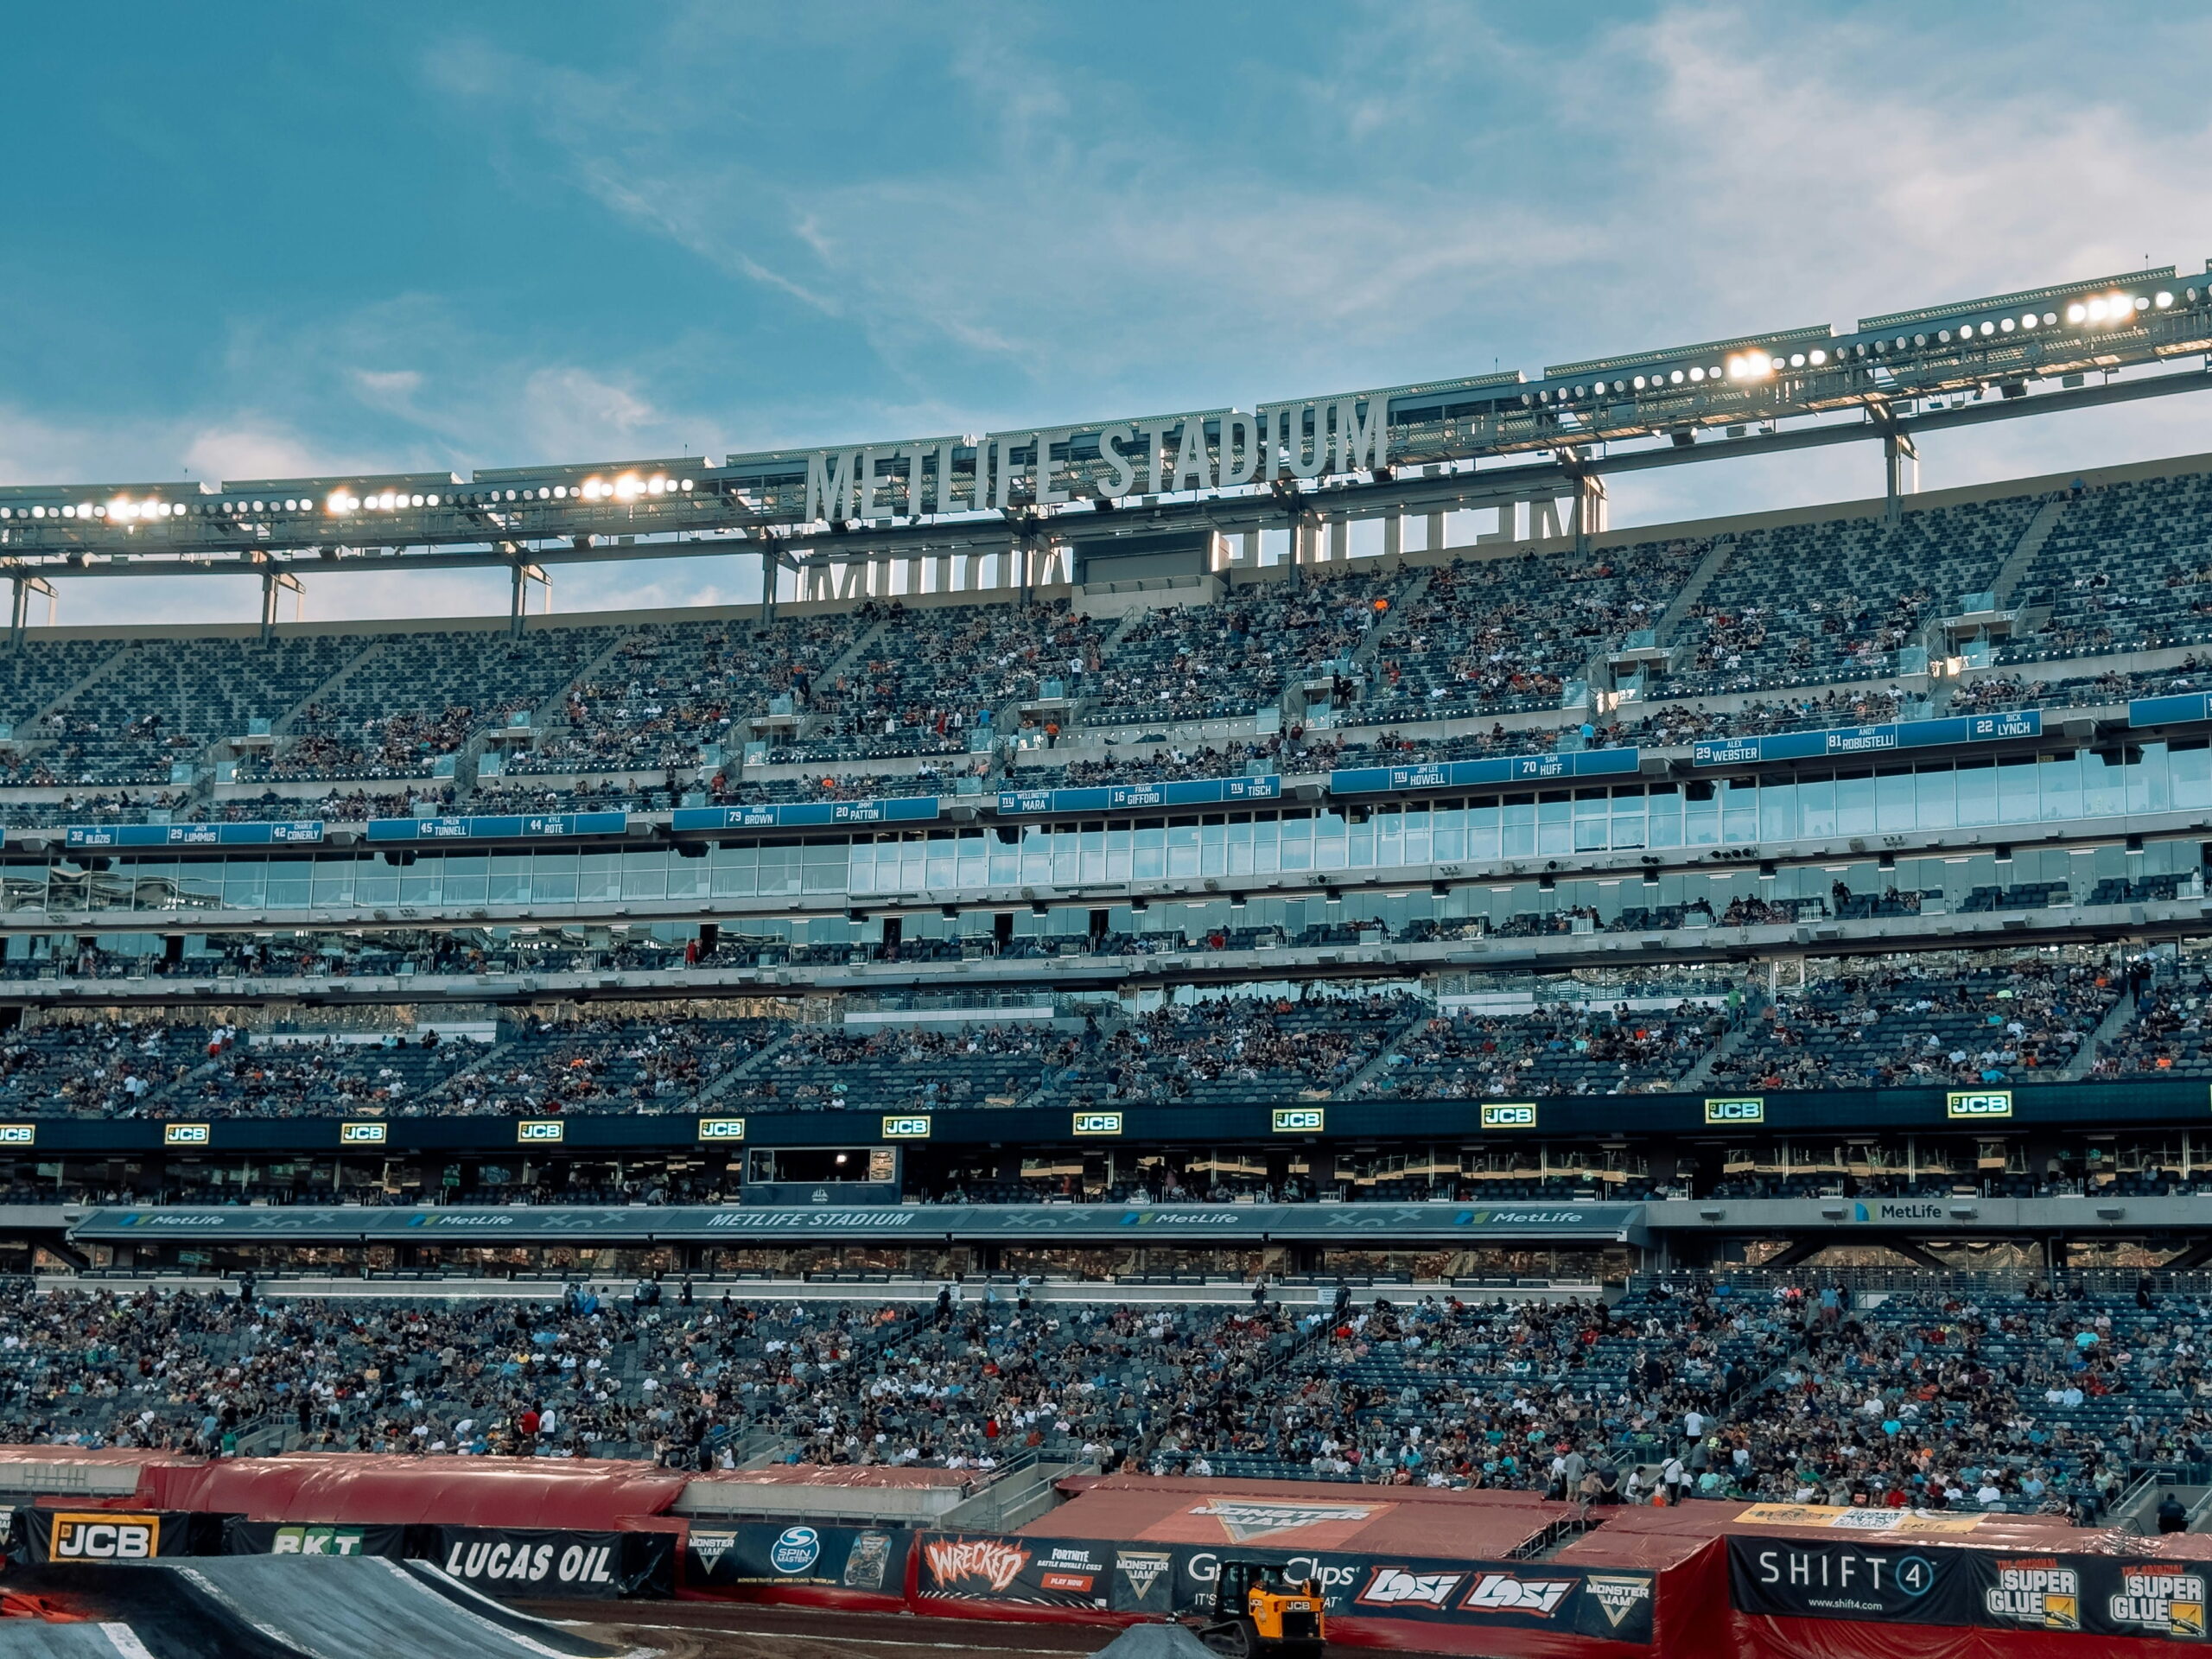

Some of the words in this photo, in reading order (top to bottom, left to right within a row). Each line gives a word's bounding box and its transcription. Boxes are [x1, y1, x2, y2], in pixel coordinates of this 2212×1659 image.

[805, 432, 1071, 521] METLIFE
[1097, 393, 1389, 499] STADIUM
[1858, 728, 1875, 736] ANDY
[1977, 720, 1993, 734] 22
[1998, 721, 2031, 736] LYNCH
[1829, 734, 1840, 747] 81
[1842, 734, 1894, 750] ROBUSTELLI
[1696, 747, 1710, 760] 29
[1713, 747, 1757, 762] WEBSTER
[1522, 761, 1536, 773] 70
[1540, 764, 1562, 776] HUFF
[1410, 773, 1446, 786] HOWELL
[1114, 791, 1125, 802] 16
[1248, 785, 1271, 797] TISCH
[1128, 792, 1160, 804] GIFFORD
[1022, 800, 1046, 810] MARA
[729, 811, 741, 822] 79
[836, 807, 848, 817] 20
[850, 809, 879, 820] PATTON
[531, 820, 541, 830] 44
[745, 814, 772, 825] BROWN
[171, 829, 182, 839] 29
[274, 827, 286, 837] 42
[421, 823, 433, 833] 45
[435, 826, 467, 836] TUNNELL
[544, 823, 563, 834] ROTE
[72, 831, 83, 841] 32
[184, 832, 216, 842] LUMMUS
[287, 830, 319, 841] CONERLY
[1952, 1096, 2007, 1113] JCB
[1485, 1109, 1532, 1123] JCB
[1710, 1103, 1759, 1119] JCB
[1077, 1116, 1118, 1131] JCB
[1276, 1113, 1319, 1128] JCB
[522, 1125, 560, 1138] JCB
[702, 1122, 741, 1136] JCB
[886, 1120, 926, 1134] JCB
[168, 1128, 206, 1141] JCB
[345, 1127, 383, 1140] JCB
[1492, 1212, 1583, 1223] MetLife
[1881, 1205, 1942, 1218] MetLife
[150, 1215, 225, 1224] MetLife
[439, 1215, 513, 1224] MetLife
[706, 1213, 808, 1226] METLIFE
[808, 1213, 915, 1226] STADIUM
[1155, 1214, 1238, 1224] MetLife
[1188, 1506, 1371, 1521] MONSTER
[1224, 1517, 1311, 1527] JAM
[59, 1525, 149, 1557] JCB
[689, 1538, 734, 1548] MONSTER
[779, 1548, 810, 1557] SPIN
[1052, 1548, 1090, 1562] FORTNITE
[446, 1541, 554, 1581] LUCAS
[559, 1545, 611, 1582] OIL
[929, 1542, 1022, 1589] WRECKED
[1116, 1560, 1169, 1571] MONSTER
[1130, 1571, 1154, 1580] JAM
[1759, 1552, 1887, 1589] SHIFT
[1905, 1564, 1920, 1588] 4
[1050, 1578, 1067, 1586] PLAY
[1067, 1579, 1084, 1587] NOW
[2005, 1569, 2075, 1594] SUPER
[2129, 1575, 2202, 1600] SUPER
[1586, 1584, 1649, 1599] MONSTER
[1195, 1593, 1217, 1605] IT'S
[1601, 1594, 1633, 1606] JAM
[1808, 1599, 1883, 1611] www.shift4.com
[1990, 1590, 2043, 1614] GLUE
[1287, 1601, 1311, 1611] JCB
[2113, 1597, 2169, 1621] GLUE
